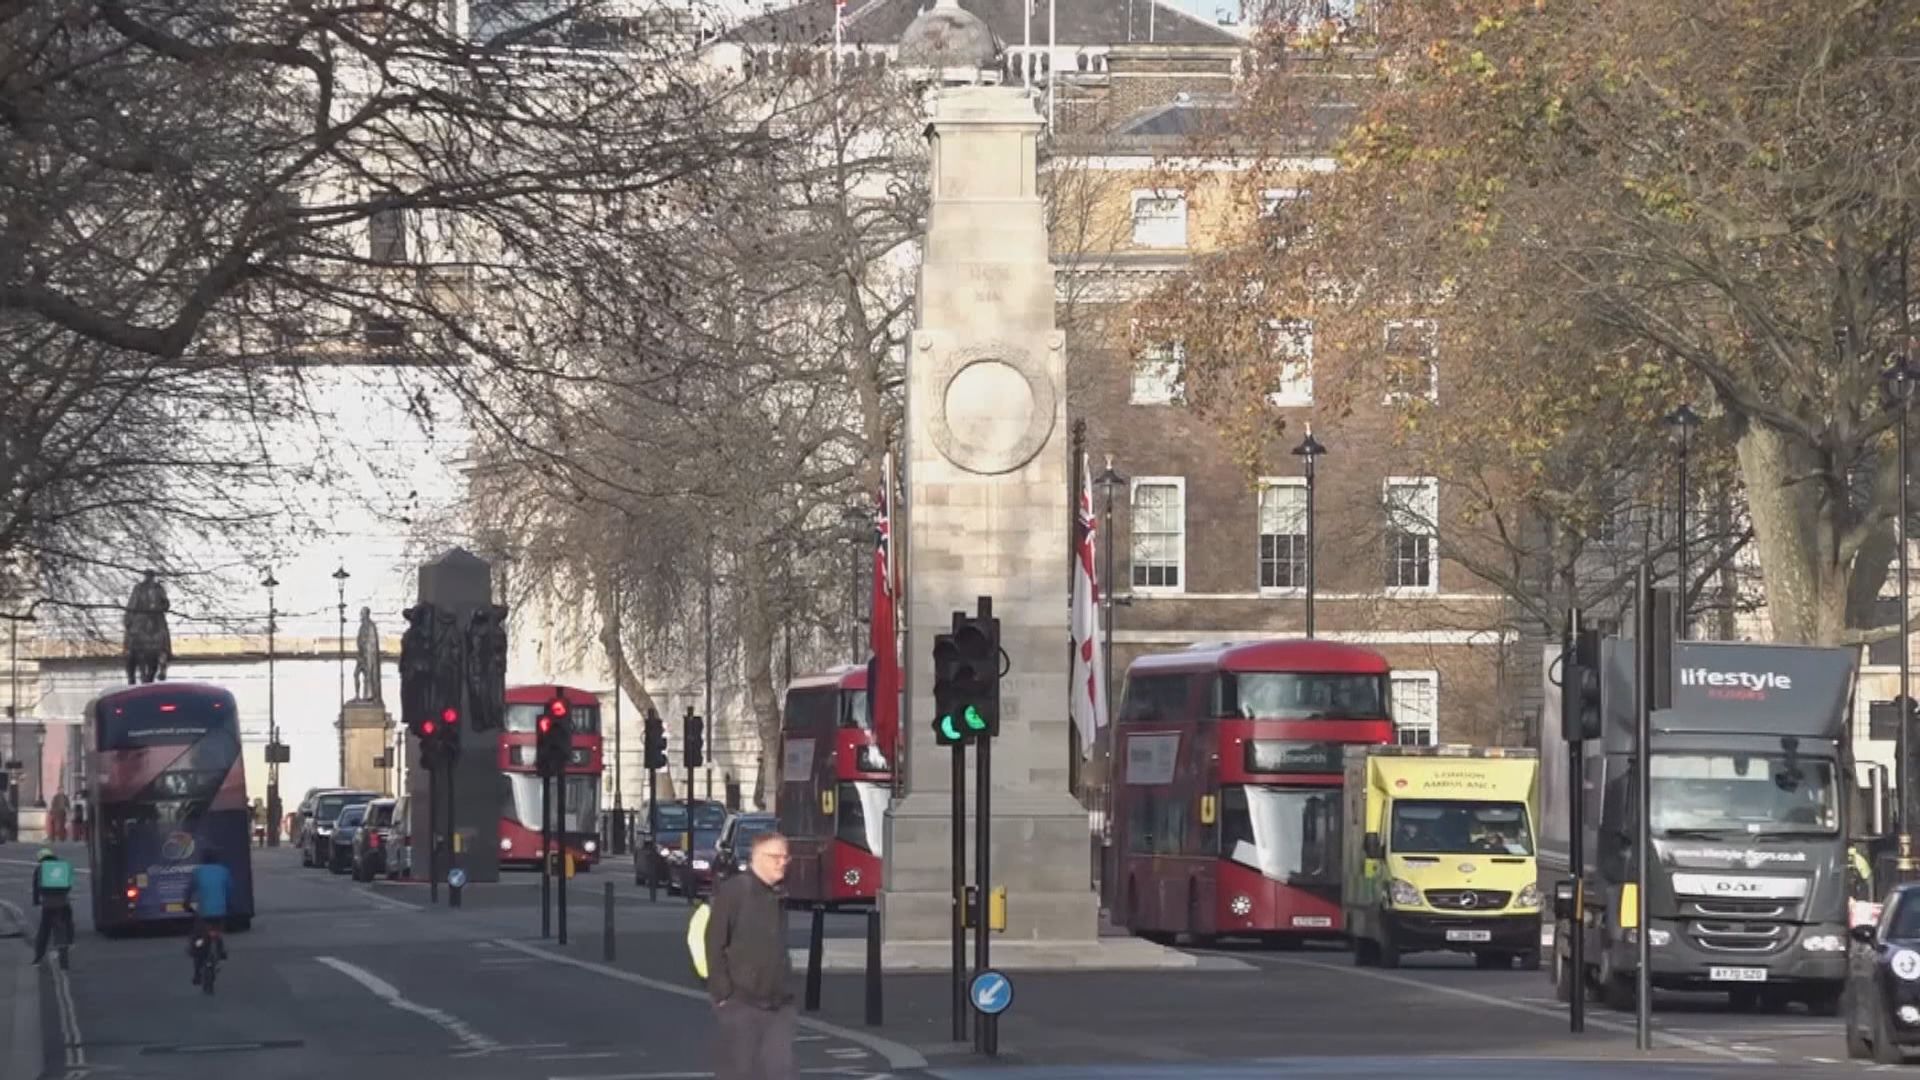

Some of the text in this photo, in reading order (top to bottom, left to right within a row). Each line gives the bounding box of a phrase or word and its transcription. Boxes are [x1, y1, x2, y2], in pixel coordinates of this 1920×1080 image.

[1681, 667, 1791, 692] lifestyle
[1423, 780, 1497, 790] AMBUANC
[1717, 882, 1763, 892] DAF
